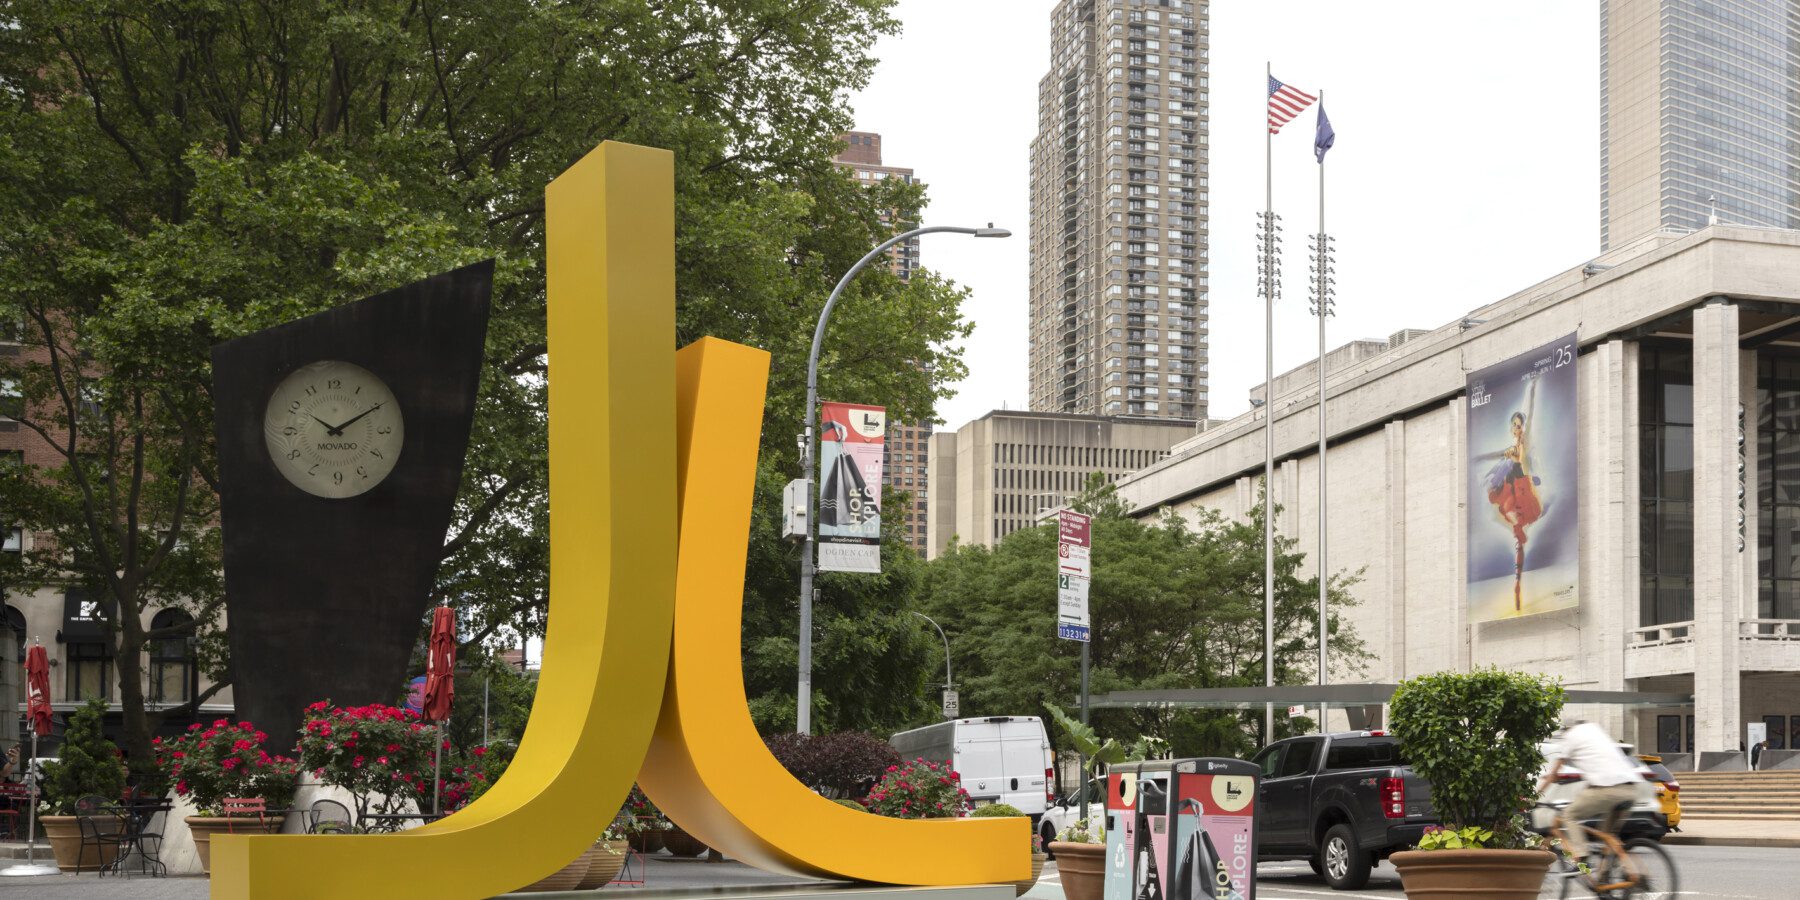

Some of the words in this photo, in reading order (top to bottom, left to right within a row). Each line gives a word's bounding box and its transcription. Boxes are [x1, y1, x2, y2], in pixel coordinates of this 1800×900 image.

[1534, 356, 1552, 368] SPRING
[1555, 344, 1572, 368] 25
[304, 385, 317, 396] 11
[327, 379, 342, 390] 12
[355, 386, 361, 395] 1
[1471, 393, 1491, 409] BALLET
[288, 400, 301, 415] 10
[283, 426, 298, 437] 9
[377, 426, 391, 435] 3
[317, 442, 358, 451] MOVADO
[287, 449, 301, 461] 8
[370, 448, 384, 460] 4
[307, 463, 320, 476] 7
[356, 466, 368, 480] 5
[333, 471, 343, 485] 6
[863, 459, 879, 534] EXPLORE.
[849, 487, 862, 533] SHOP.
[1060, 512, 1067, 520] NO
[1067, 513, 1086, 524] STANDING
[825, 548, 856, 557] OGDEN
[858, 550, 875, 558] CAP
[1061, 575, 1067, 588] 2
[1231, 828, 1248, 900] XPLORE.
[1215, 860, 1230, 900] HOP
